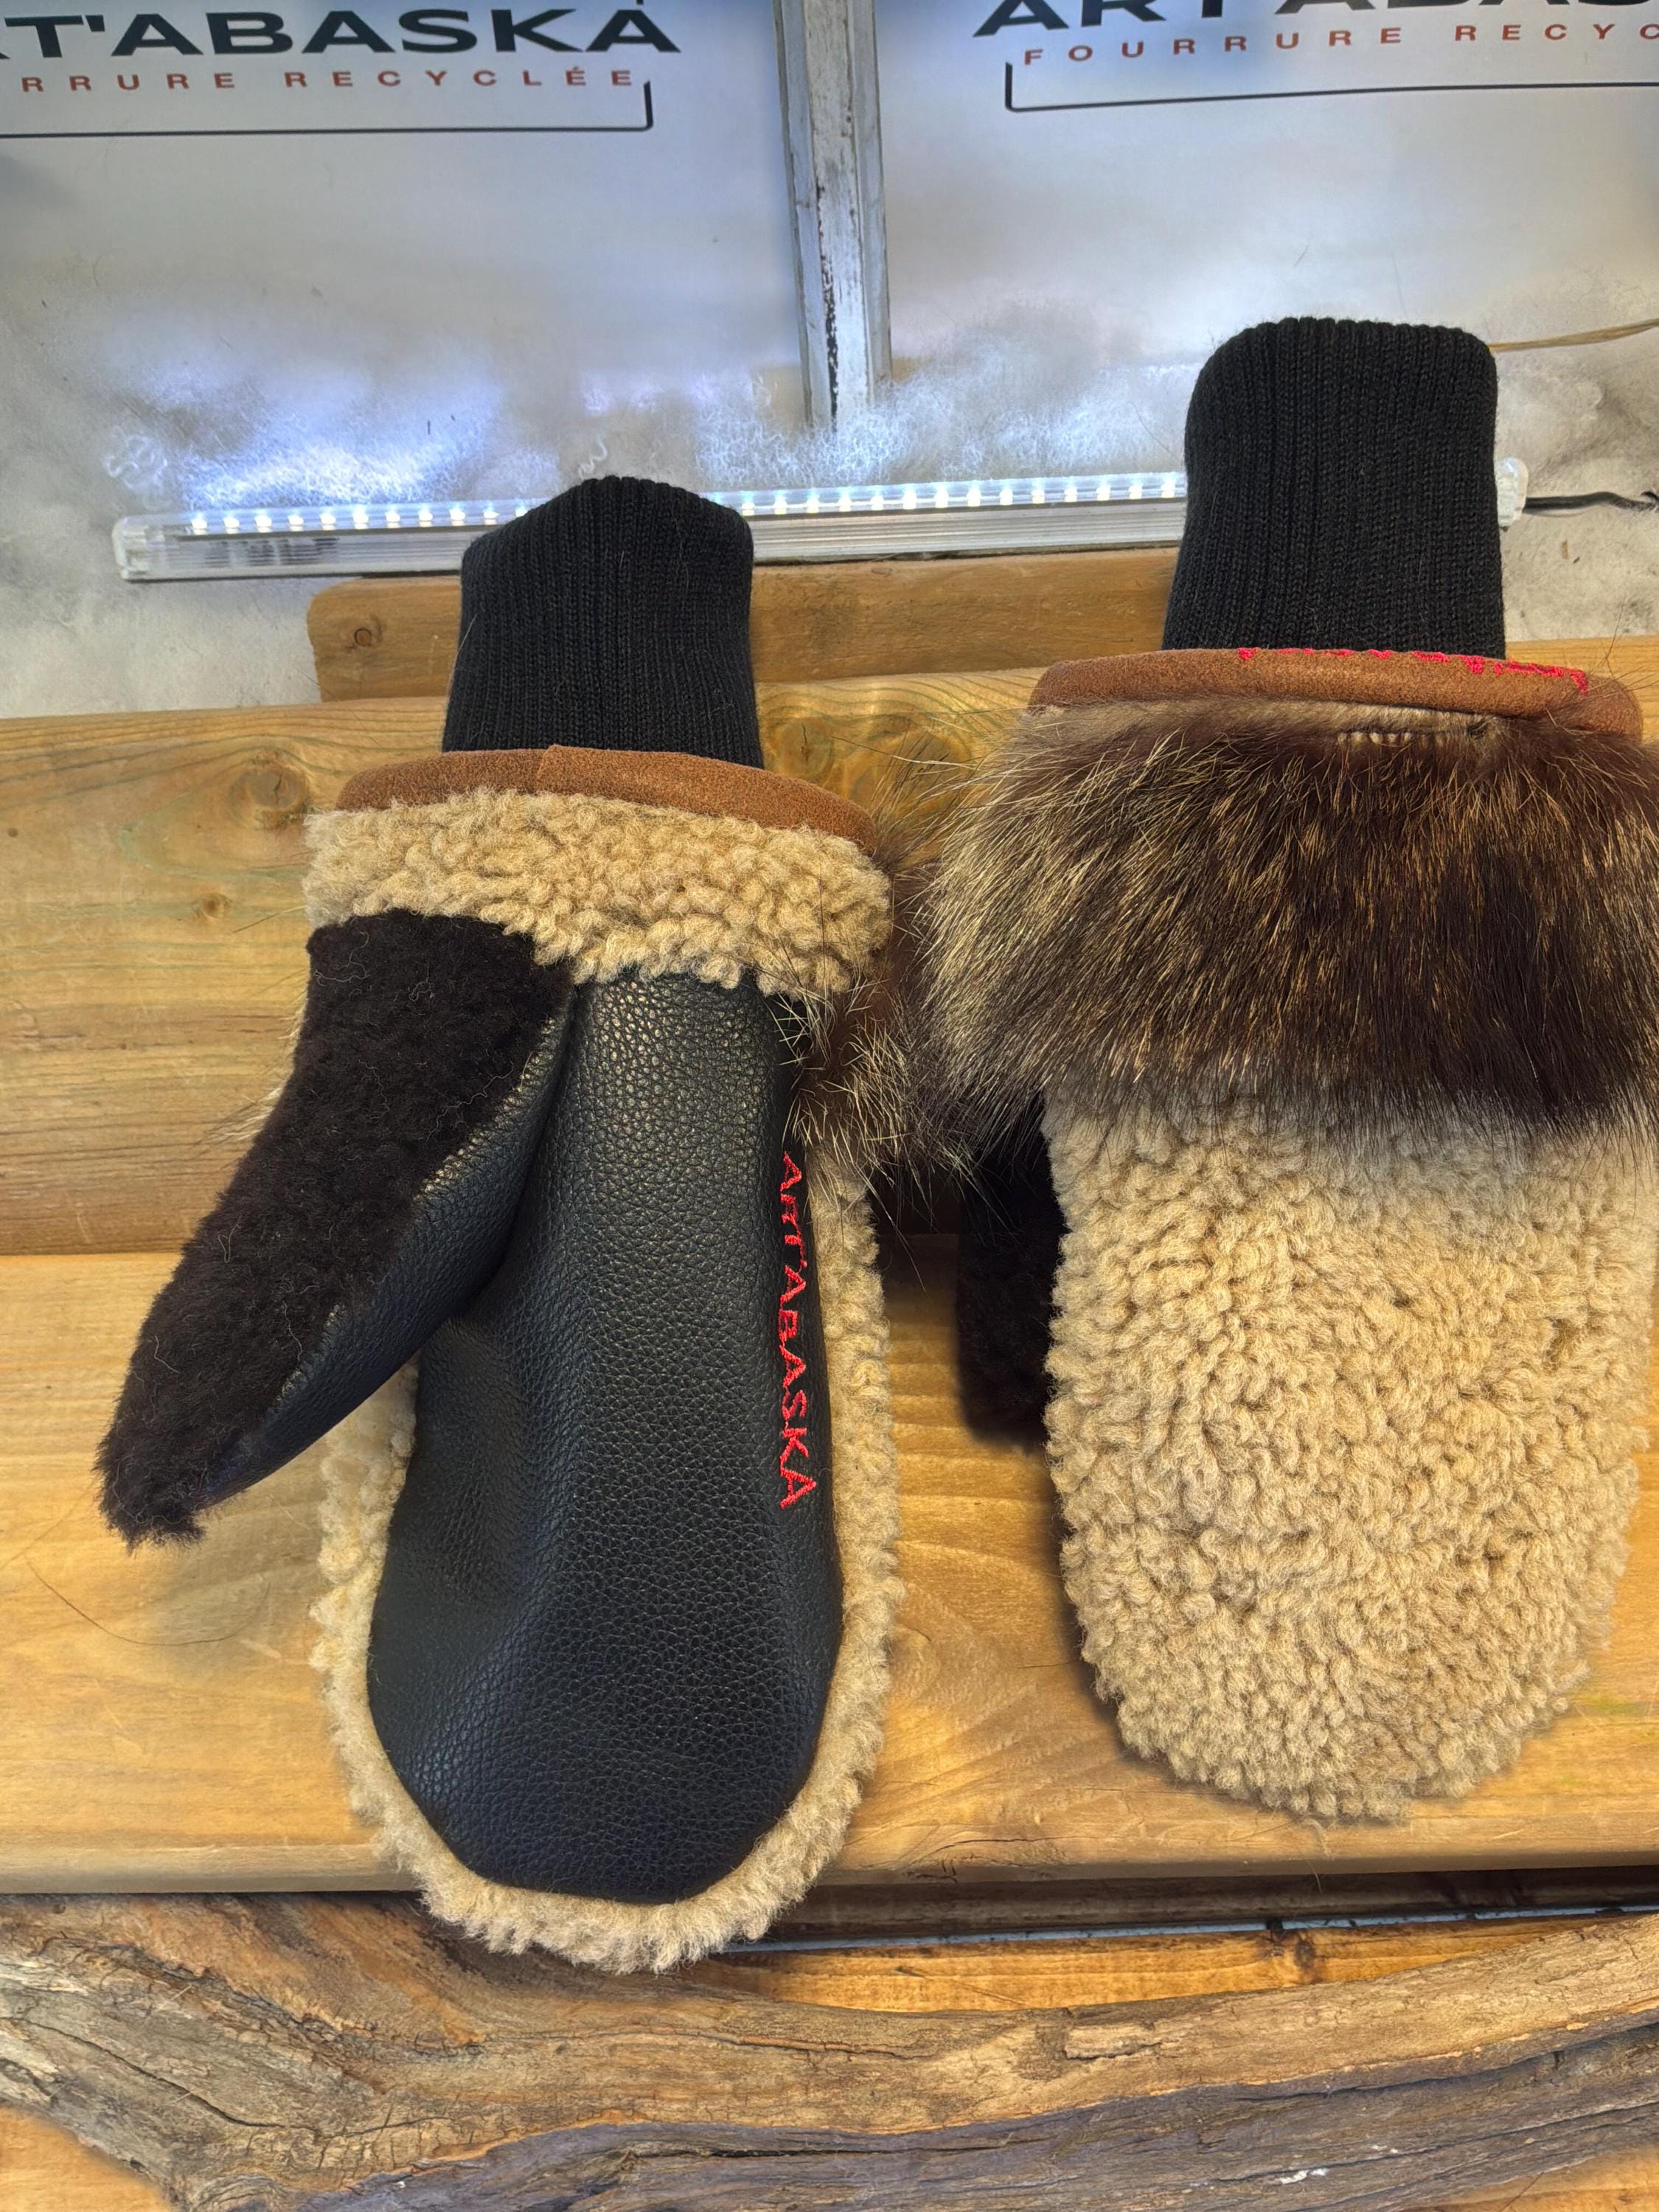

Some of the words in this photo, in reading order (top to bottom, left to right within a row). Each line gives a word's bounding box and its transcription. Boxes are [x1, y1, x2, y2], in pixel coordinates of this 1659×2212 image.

[0, 9, 681, 59] T'ABASKA
[1024, 27, 1402, 66] FOURRURE
[21, 72, 236, 93] RRURE
[285, 66, 632, 89] RECYCLÉE
